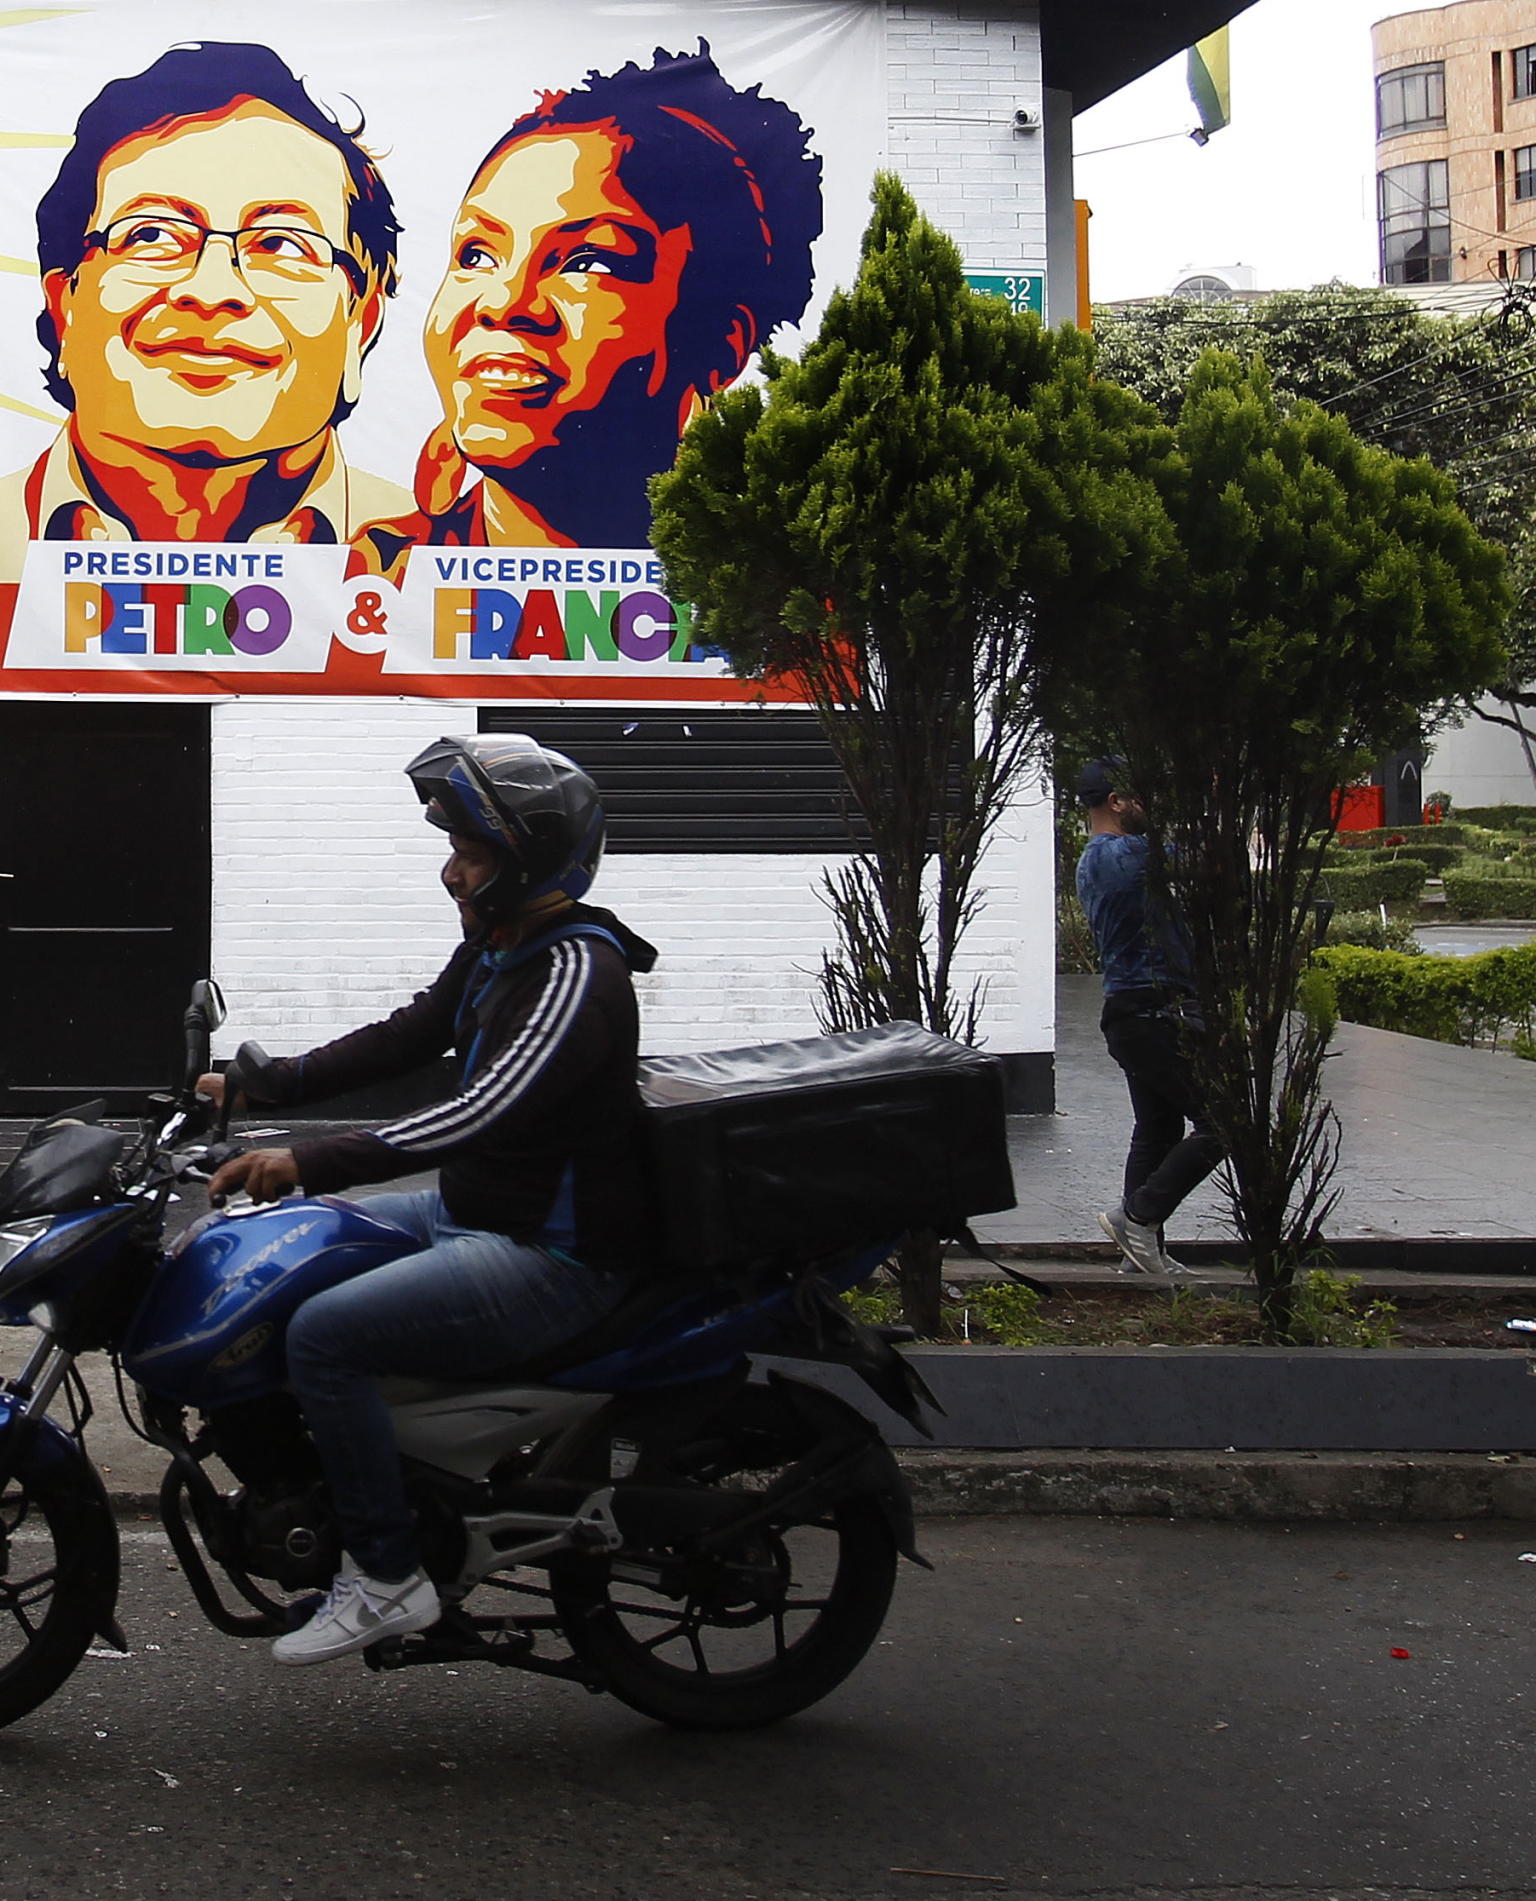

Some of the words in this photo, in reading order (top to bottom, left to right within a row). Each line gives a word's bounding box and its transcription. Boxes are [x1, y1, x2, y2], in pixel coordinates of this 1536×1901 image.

[1004, 277, 1031, 300] 32
[63, 551, 285, 578] PRESIDENTE
[63, 581, 293, 657] PETRO
[346, 590, 389, 636] &
